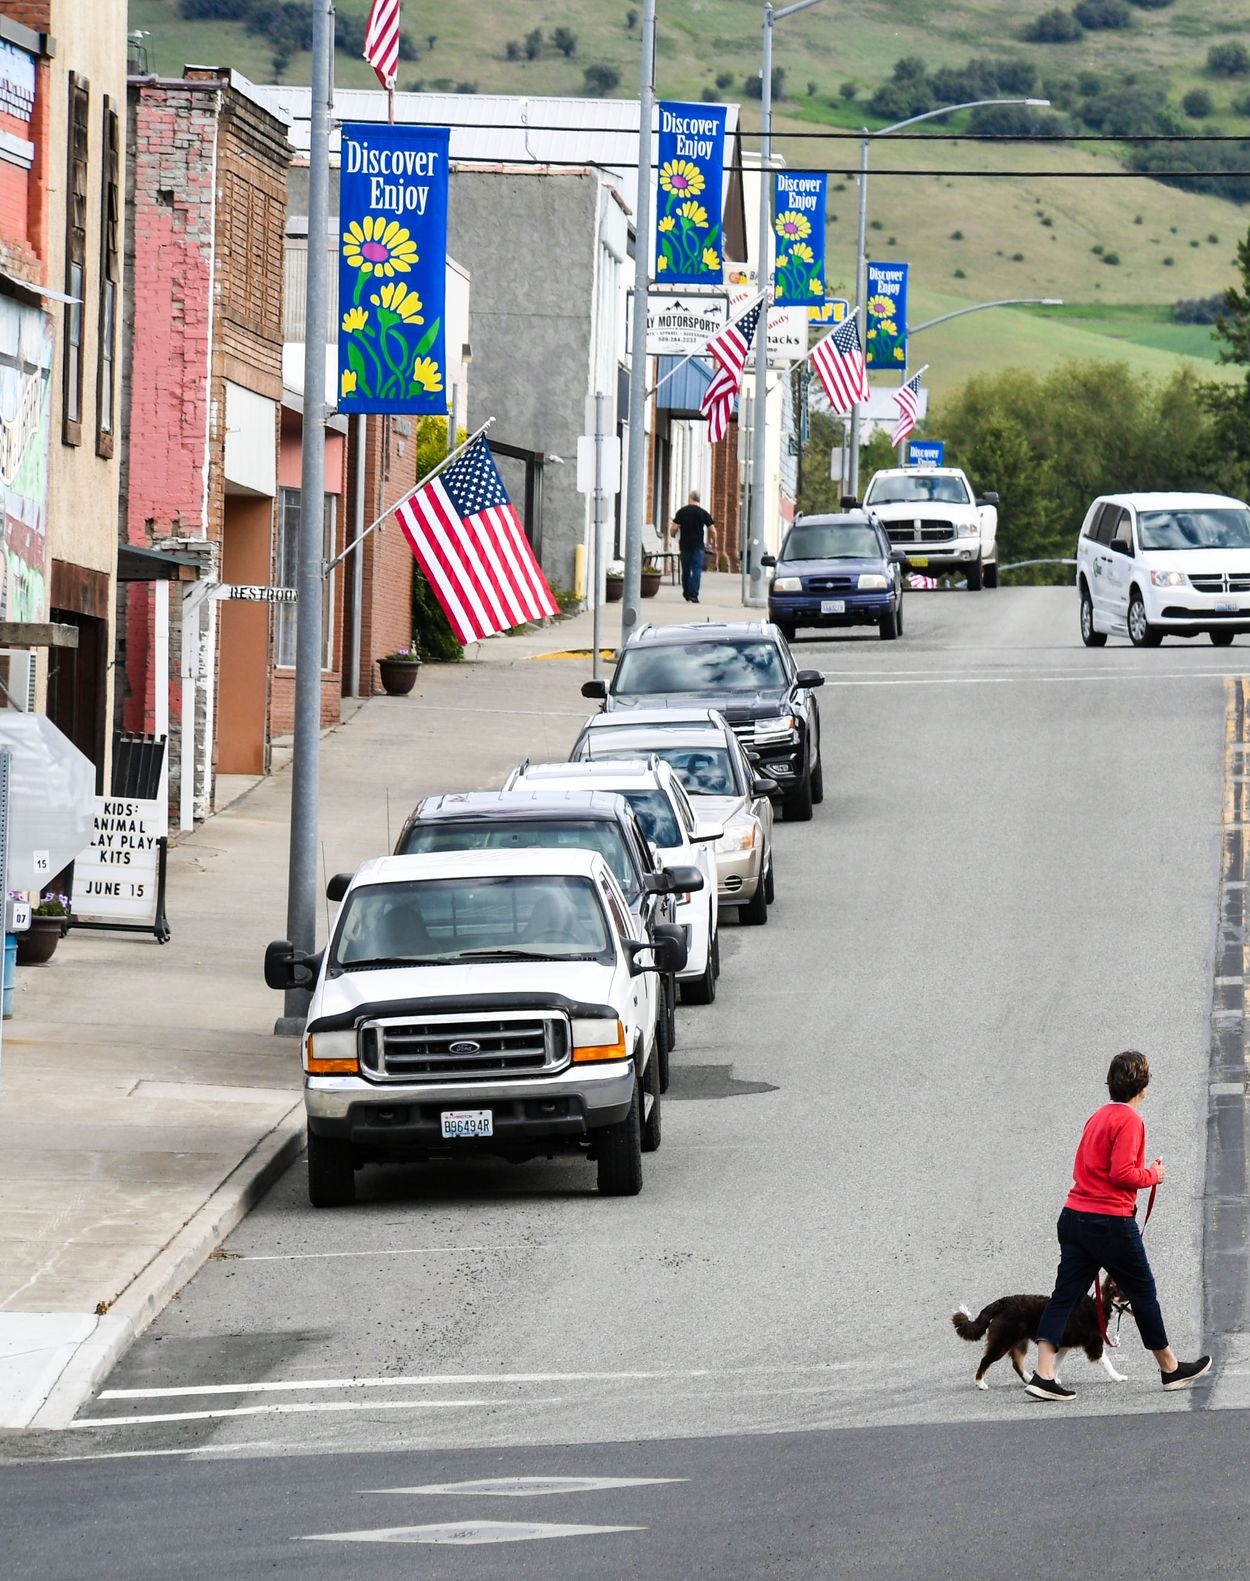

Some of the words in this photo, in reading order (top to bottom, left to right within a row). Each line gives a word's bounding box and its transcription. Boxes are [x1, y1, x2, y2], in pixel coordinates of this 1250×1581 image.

[662, 111, 720, 136] Discover
[677, 134, 713, 160] Enjoy
[347, 141, 439, 176] Discover
[778, 175, 823, 192] Discover
[369, 177, 430, 216] Enjoy
[789, 191, 817, 211] Enjoy
[869, 267, 904, 281] Discover
[877, 280, 900, 296] Enjoy
[808, 302, 846, 321] AFE
[658, 316, 720, 333] MOTORSPORTS
[767, 314, 789, 330] andy
[766, 333, 800, 345] nacks
[910, 446, 939, 458] Discover
[104, 803, 138, 816] KIDS:
[94, 818, 146, 833] ANIMAL
[37, 859, 47, 869] 15
[100, 850, 131, 864] KITS
[86, 881, 121, 896] JUNE
[131, 884, 144, 897] 15
